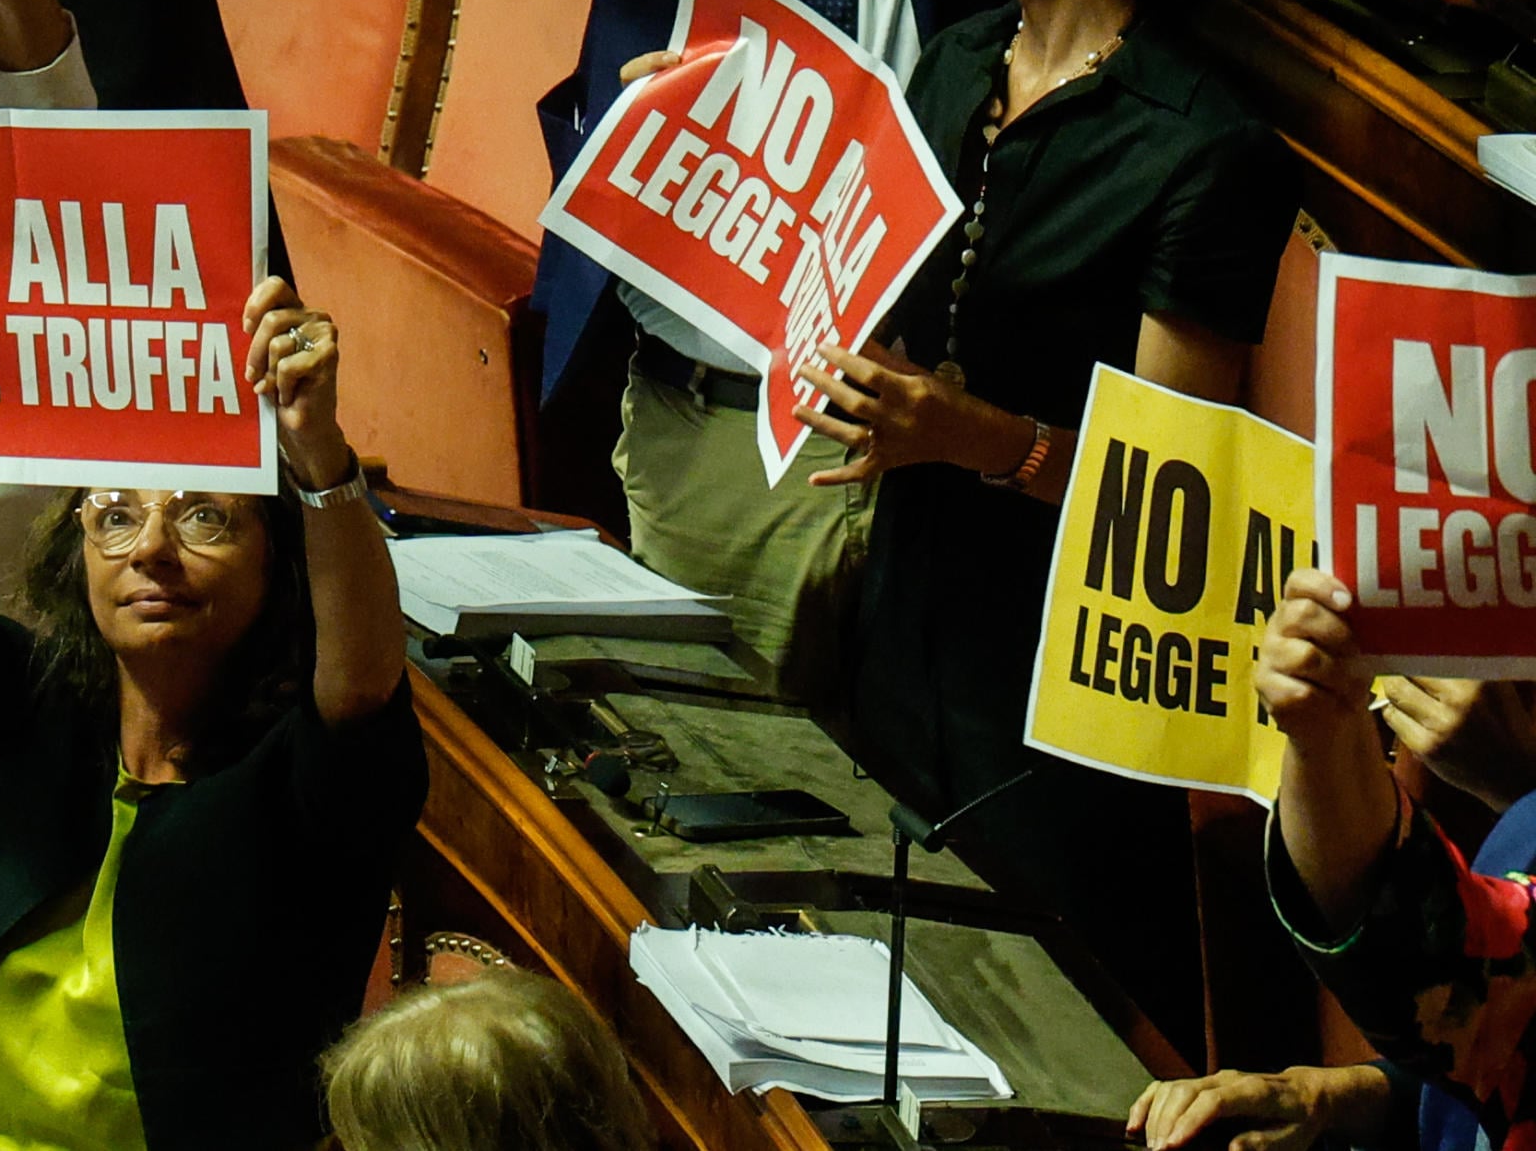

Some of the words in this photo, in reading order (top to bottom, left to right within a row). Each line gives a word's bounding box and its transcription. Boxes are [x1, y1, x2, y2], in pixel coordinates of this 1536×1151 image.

[608, 109, 797, 286] LEGGE
[687, 15, 834, 193] NO
[809, 139, 888, 315] ALLA
[8, 198, 206, 310] ALLA
[5, 314, 240, 414] TRUFFA
[1084, 438, 1211, 614] NO
[1356, 504, 1536, 608] LEGG
[1069, 605, 1229, 717] LEGGE
